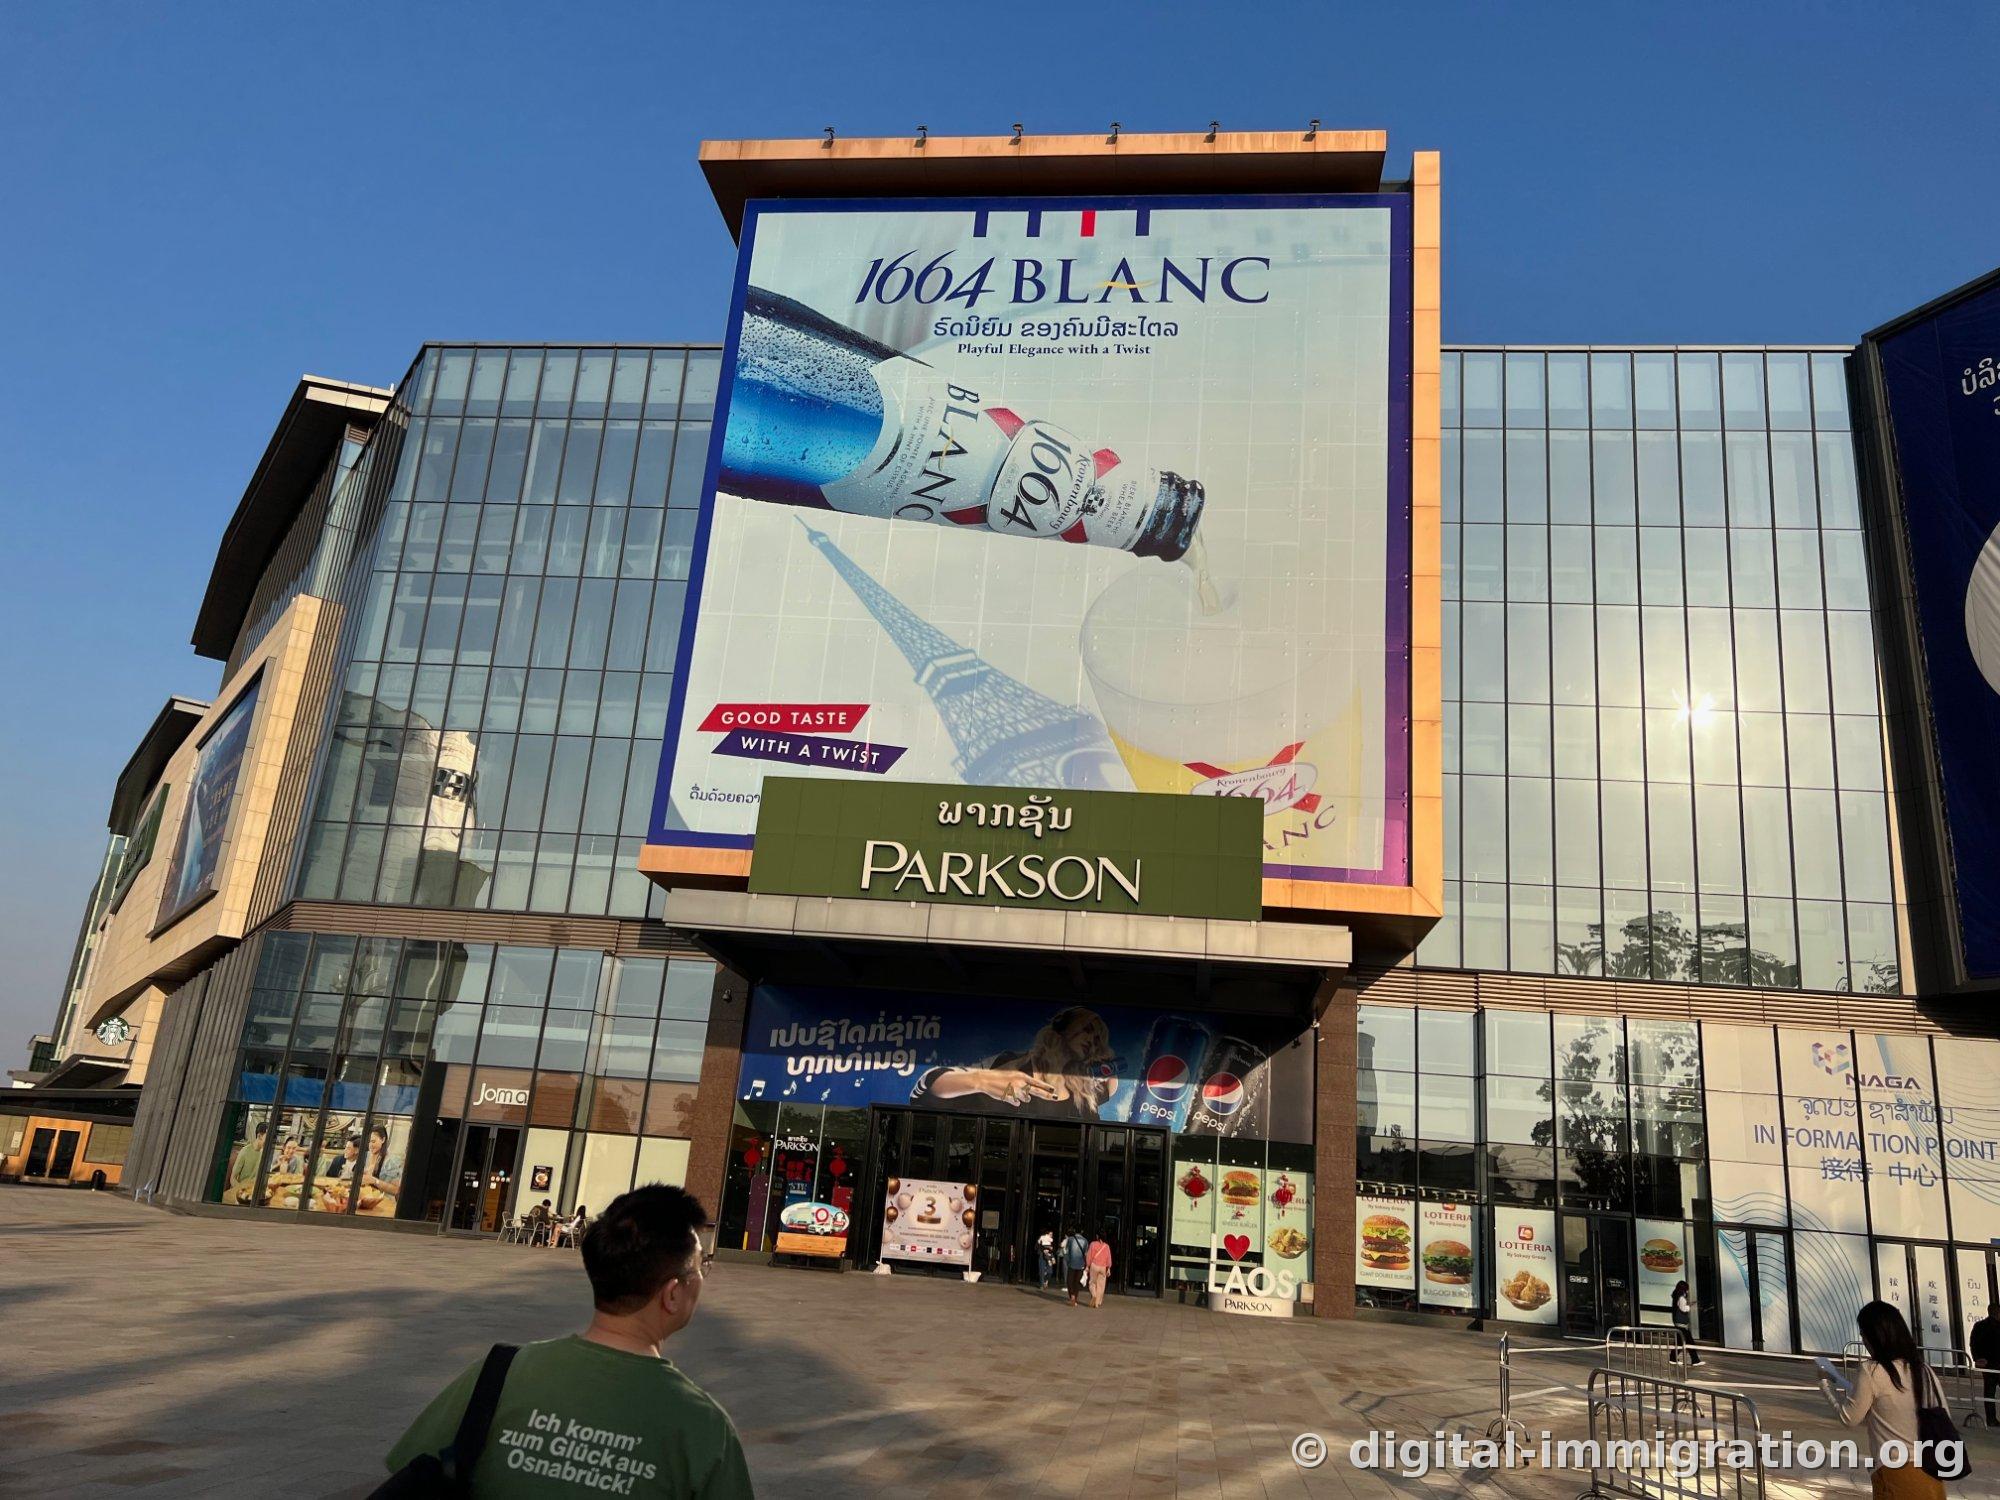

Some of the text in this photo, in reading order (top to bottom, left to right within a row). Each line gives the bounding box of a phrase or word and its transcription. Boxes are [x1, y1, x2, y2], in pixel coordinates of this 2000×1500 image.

[855, 249, 1271, 309] 1664 BLANC
[958, 343, 1003, 356] Playful
[1009, 344, 1064, 357] Elegance
[1068, 344, 1098, 354] with
[1114, 343, 1151, 354] Twist
[893, 383, 980, 520] BLANC
[1000, 428, 1073, 531] 1664
[1049, 454, 1092, 530] Kronenbourg
[721, 712, 847, 725] GOOD TASTE
[741, 736, 791, 754] WITH
[799, 744, 811, 758] A
[1216, 766, 1287, 787] Kronenbourg
[938, 794, 1073, 838] ພາກຊັນ
[860, 840, 1142, 905] PARKSON
[1845, 1073, 1921, 1090] NAGA
[473, 1082, 529, 1106] Joma
[1140, 1102, 1177, 1122] pepsi
[1192, 1111, 1227, 1133] pepsi
[775, 1140, 820, 1151] PARKSON
[924, 1196, 936, 1216] 3
[1424, 1211, 1473, 1222] LOTTERIA
[1499, 1240, 1552, 1253] LOTTERIA
[1208, 1262, 1296, 1299] LAOS
[1224, 1298, 1272, 1312] PARKSON
[528, 1409, 561, 1434] Ich
[499, 1429, 657, 1480] zum Glück aus
[507, 1449, 635, 1496] Osnabrück!
